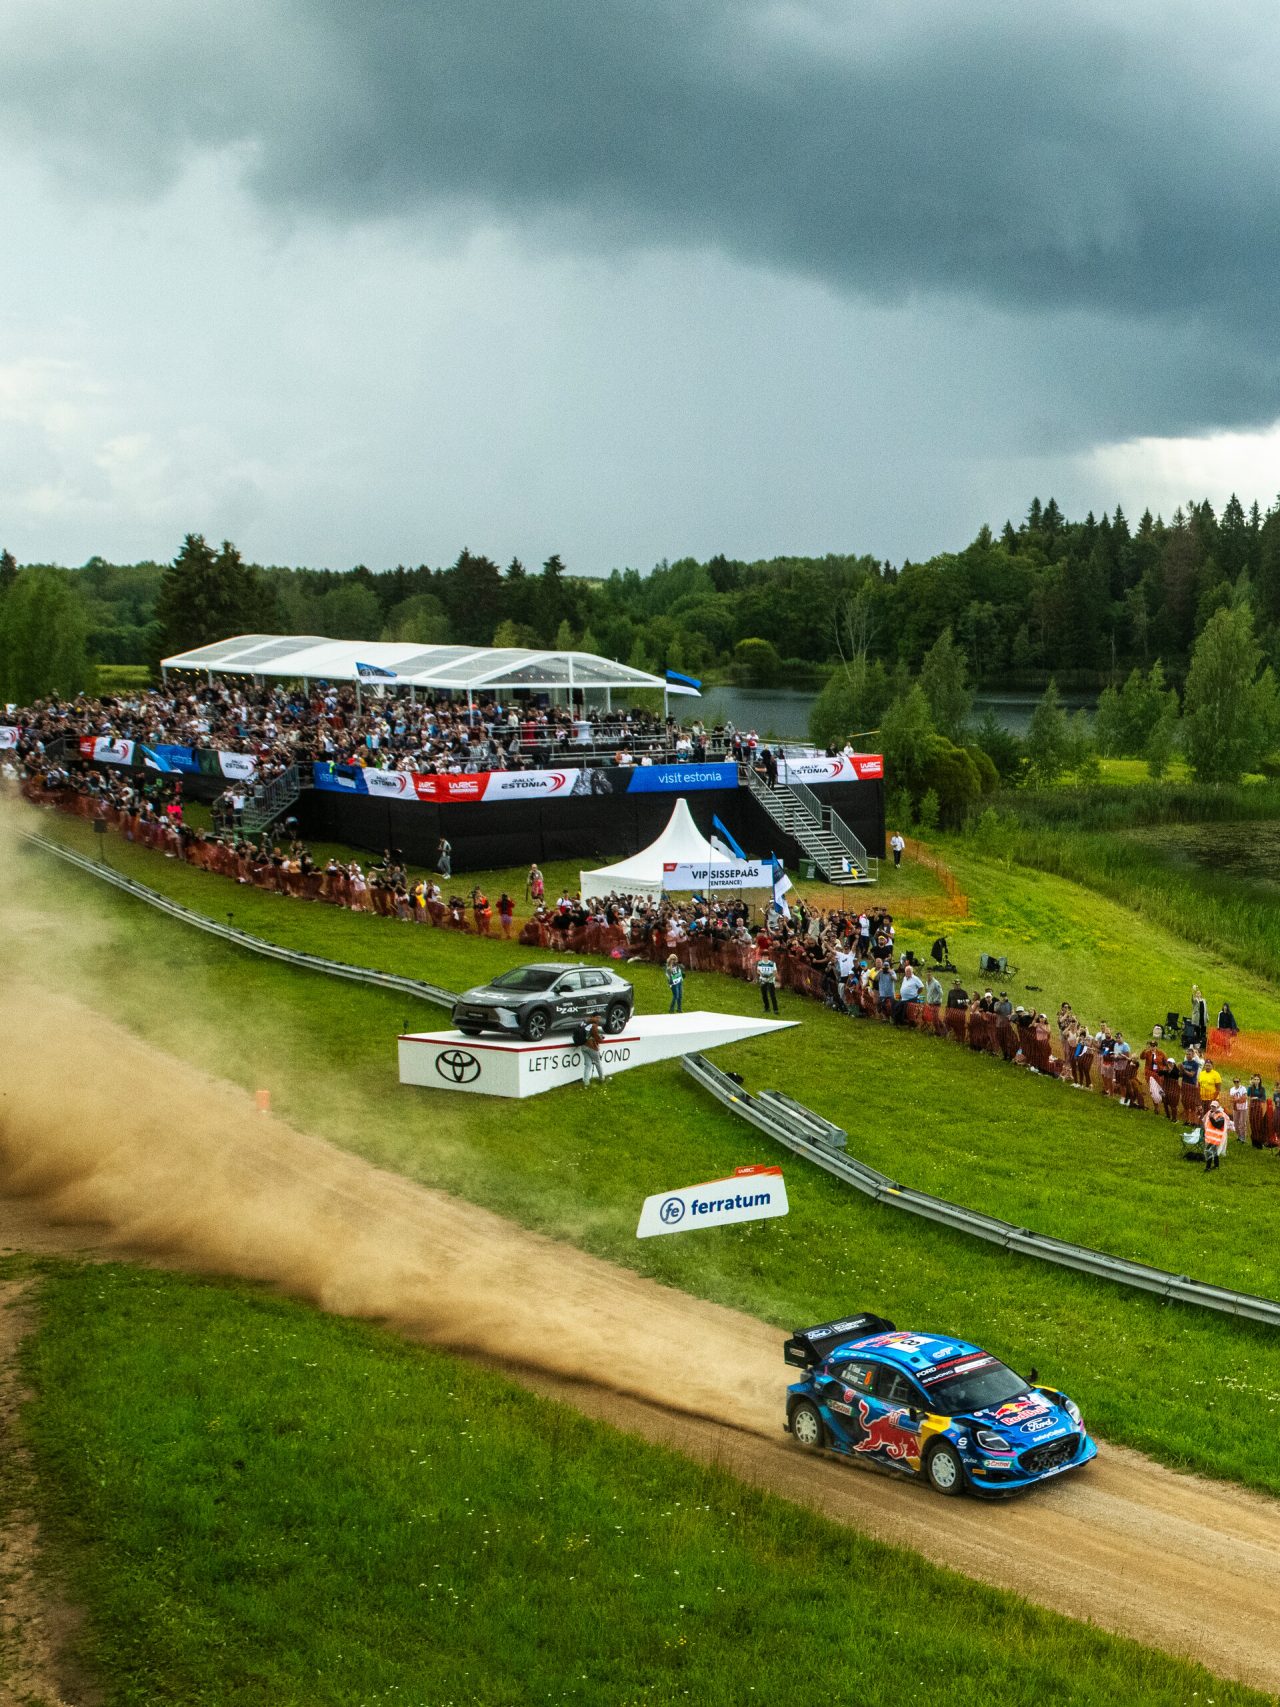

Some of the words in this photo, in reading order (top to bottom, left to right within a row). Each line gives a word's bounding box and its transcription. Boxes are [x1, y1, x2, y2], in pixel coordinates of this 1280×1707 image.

[658, 772, 682, 784] visit
[683, 771, 722, 783] estonia
[501, 781, 548, 789] ESTONIA
[692, 870, 708, 879] VIP
[529, 1055, 559, 1072] LET'S
[562, 1052, 581, 1068] GO
[691, 1192, 771, 1216] ferratum
[863, 1370, 873, 1386] 8
[915, 1367, 937, 1378] FORD
[1027, 1417, 1053, 1432] Ford
